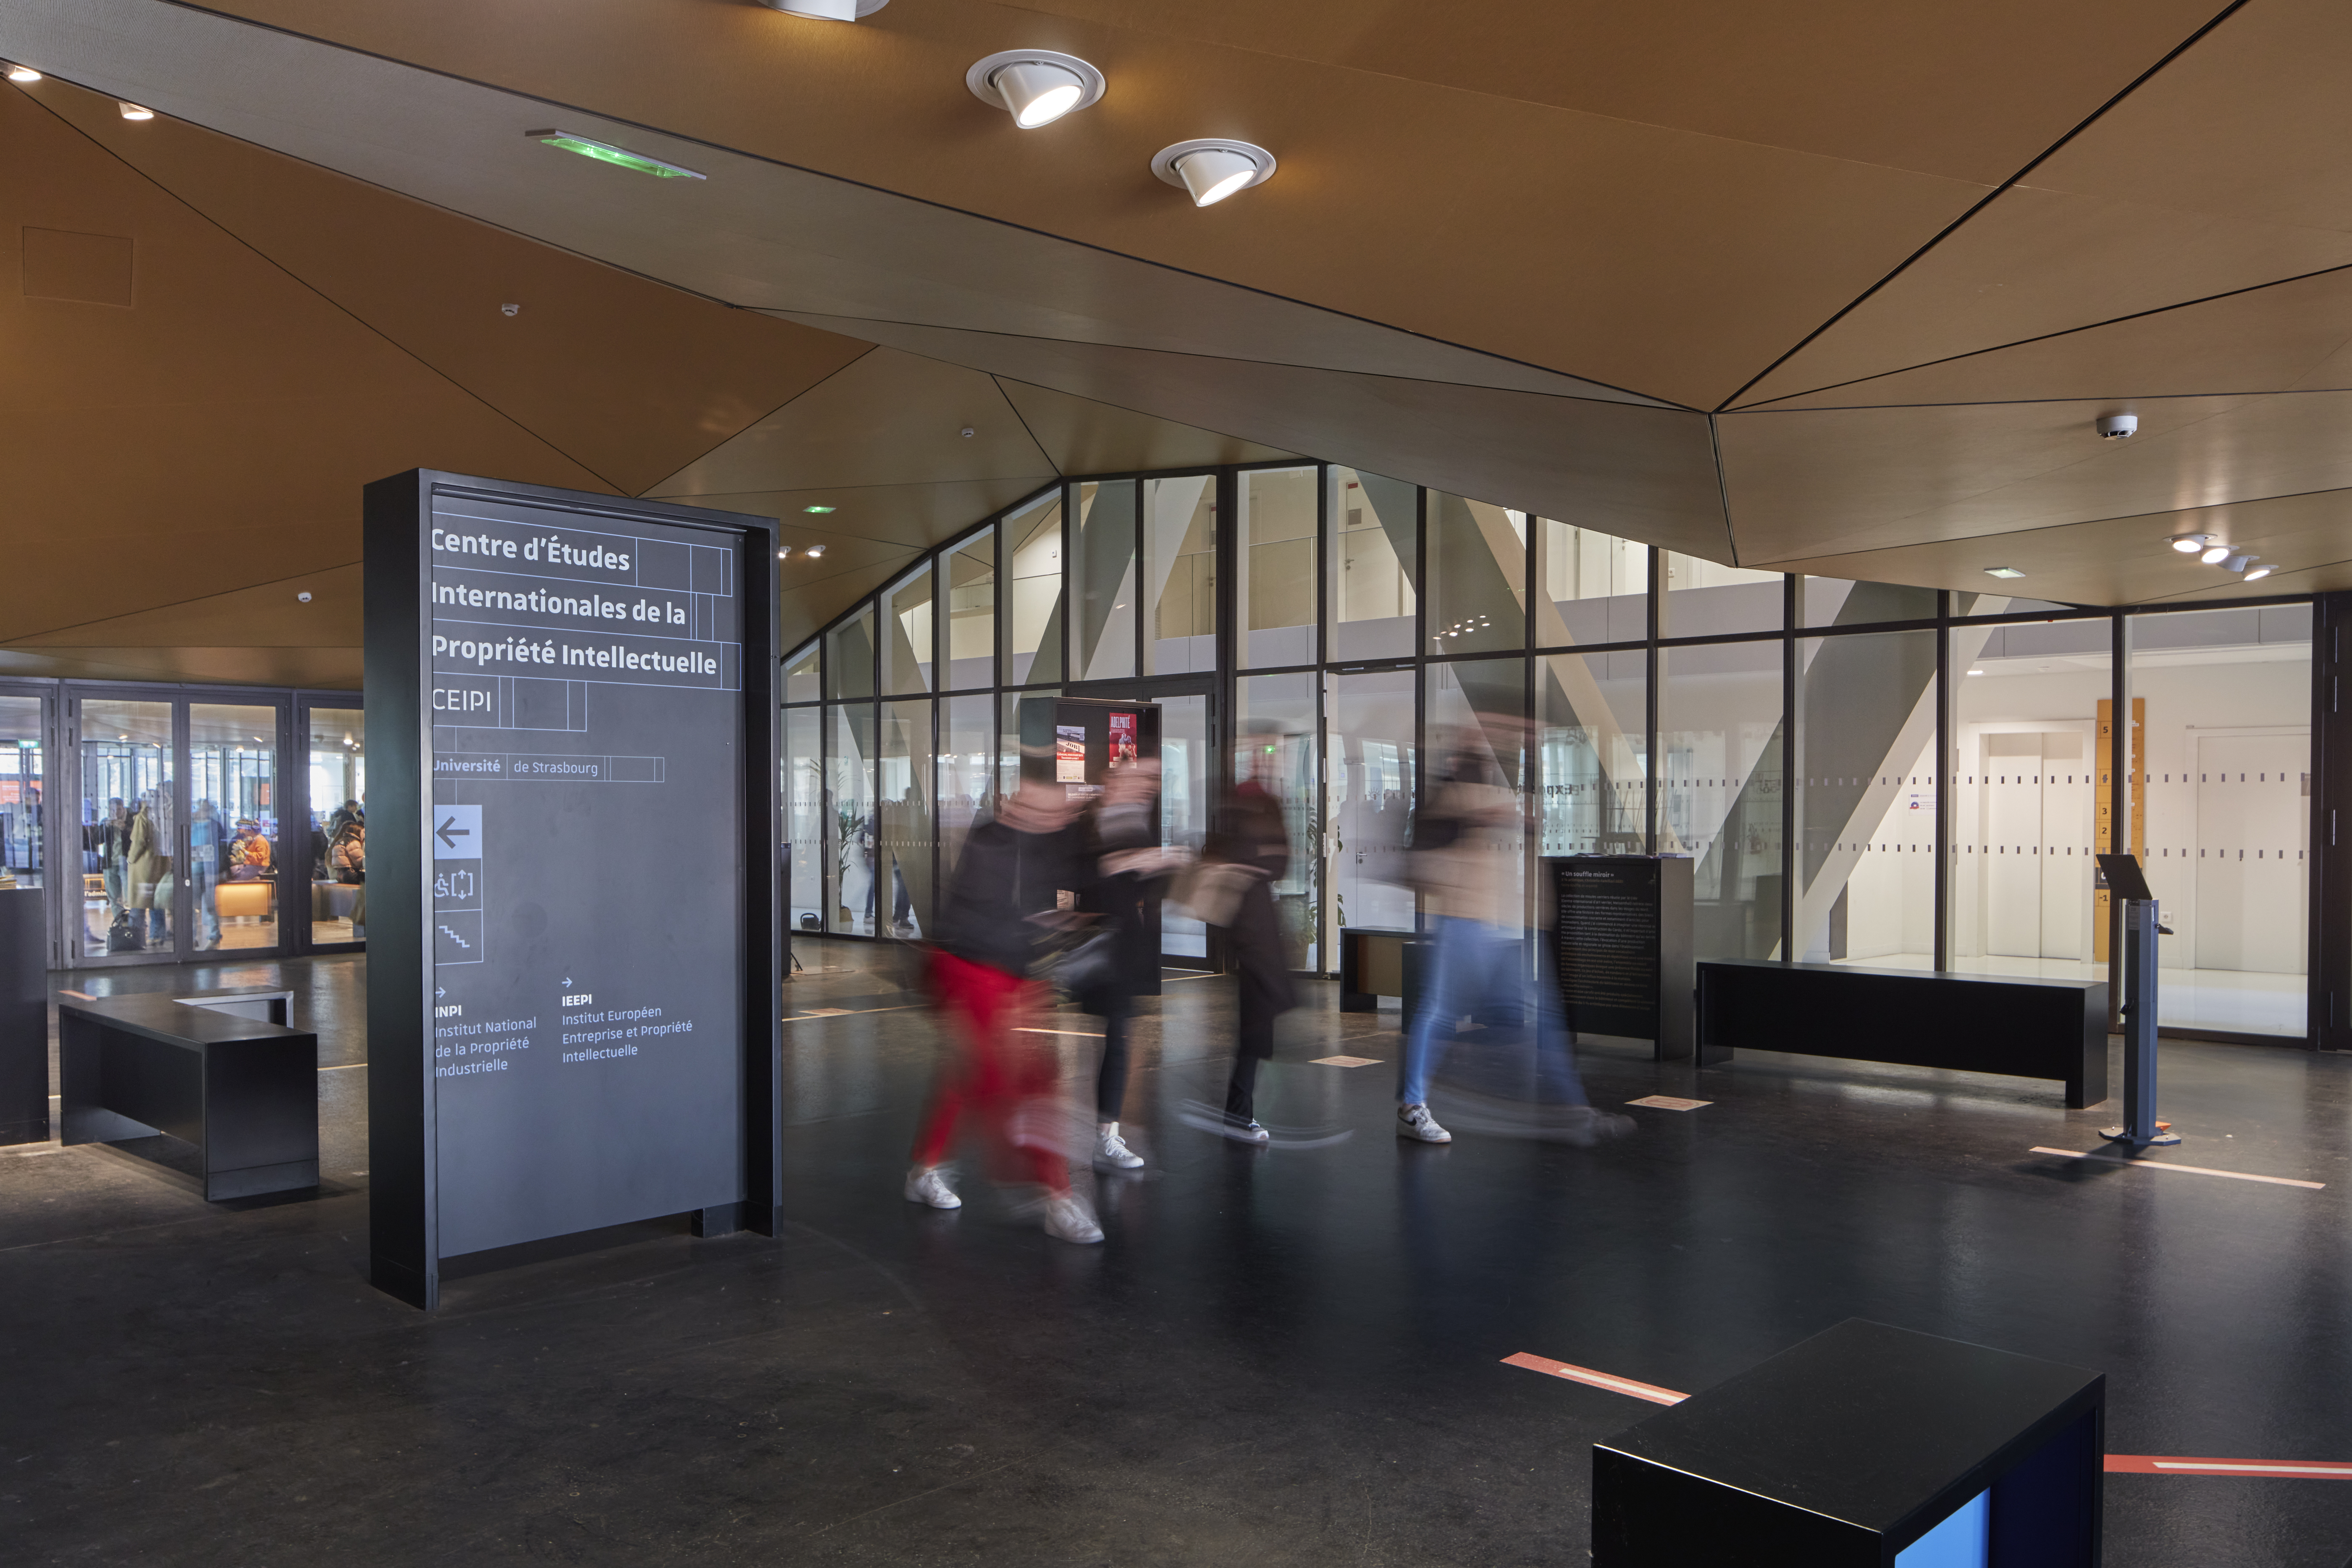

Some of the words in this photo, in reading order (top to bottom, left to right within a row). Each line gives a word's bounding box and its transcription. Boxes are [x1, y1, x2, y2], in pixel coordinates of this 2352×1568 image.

[432, 528, 517, 558] Centre
[524, 535, 630, 571] d’Études
[432, 582, 627, 620] Internationales
[632, 599, 661, 622] de
[667, 601, 685, 625] la
[433, 635, 556, 666] Propriété
[563, 645, 717, 675] Intellectuelle
[433, 688, 491, 712] CEIPI
[1111, 715, 1130, 728] ADELPHITÉ
[433, 758, 501, 772] Université
[514, 760, 529, 772] de
[533, 761, 598, 777] Strasbourg
[562, 994, 592, 1007] IEEPI
[435, 1005, 462, 1018] INPI
[563, 1012, 604, 1025] Institut
[608, 1006, 662, 1022] Européen
[436, 1024, 481, 1038] Institut
[486, 1016, 536, 1033] National
[563, 1028, 623, 1044] Entreprise
[627, 1027, 638, 1037] et
[641, 1020, 693, 1037] Propriété
[436, 1045, 451, 1058] de
[456, 1043, 466, 1055] la
[470, 1036, 529, 1055] Propriété
[563, 1044, 638, 1063] Intellectuelle
[436, 1058, 508, 1078] Industrielle
